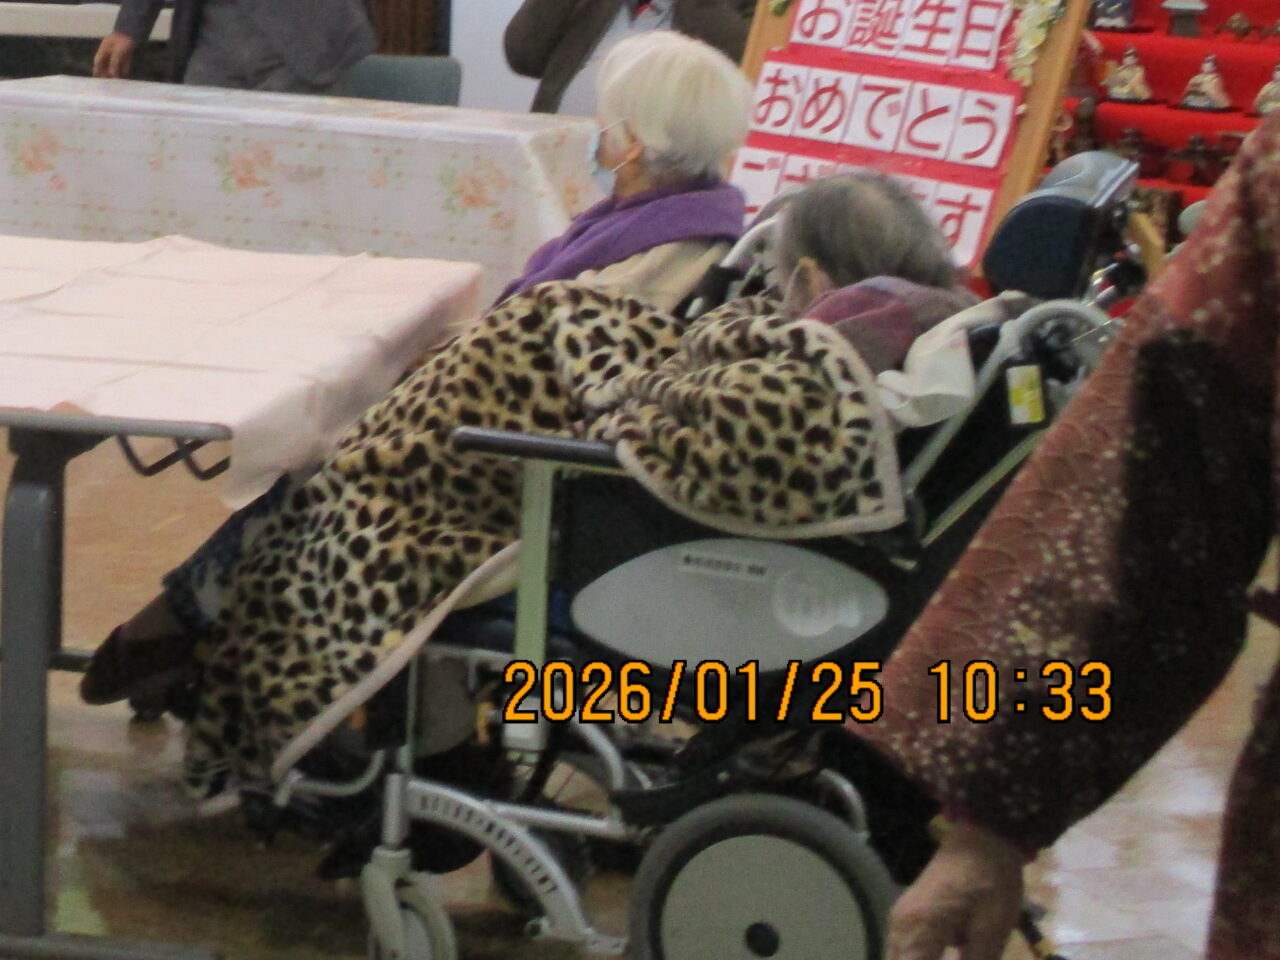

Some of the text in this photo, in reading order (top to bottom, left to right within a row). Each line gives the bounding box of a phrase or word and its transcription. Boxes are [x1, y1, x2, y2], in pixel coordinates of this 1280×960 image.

[752, 68, 1001, 160] おめでとう
